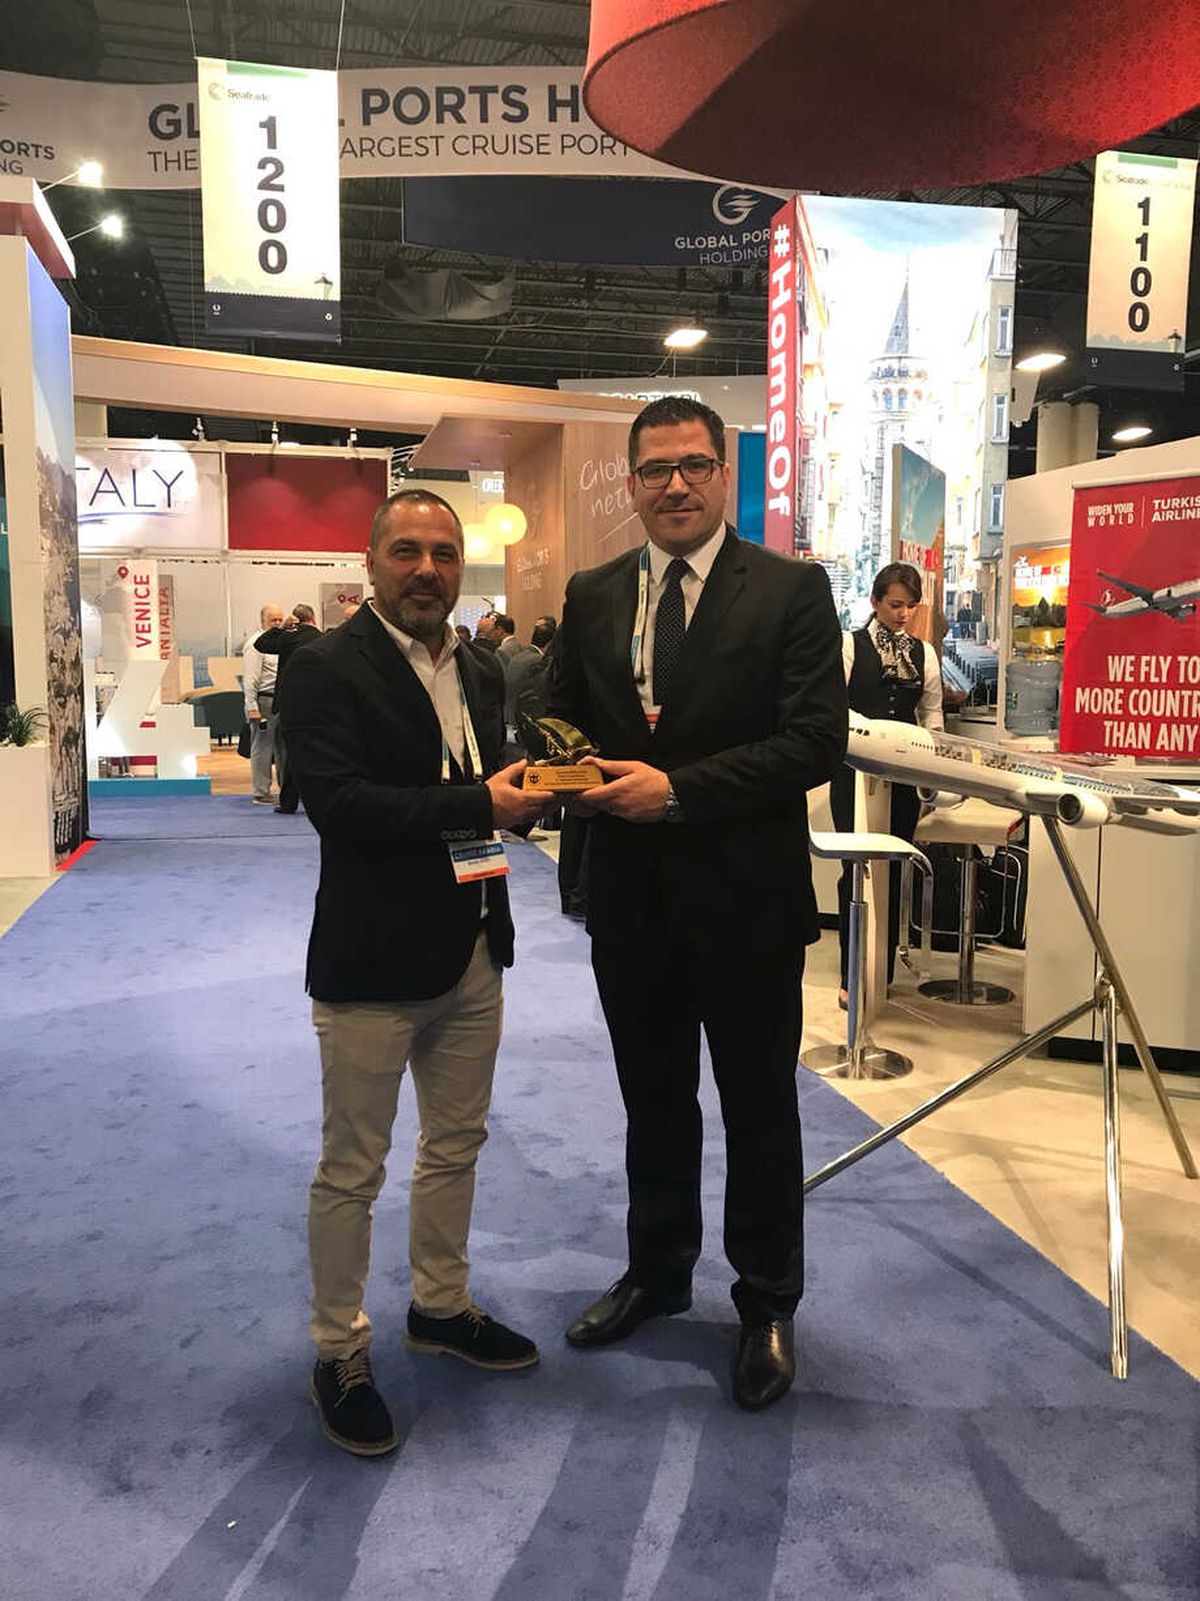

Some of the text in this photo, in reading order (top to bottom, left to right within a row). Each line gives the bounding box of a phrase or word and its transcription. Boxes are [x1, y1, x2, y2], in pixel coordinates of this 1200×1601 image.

[361, 84, 529, 126] PORTS
[147, 150, 199, 172] THE
[340, 136, 444, 159] ARGEST
[452, 134, 550, 156] CRUISE
[257, 116, 288, 274] 1200
[674, 234, 738, 249] GLOBAL
[700, 245, 768, 265] HOLDING
[1128, 197, 1151, 333] 1100
[769, 223, 791, 516] #HomeOf
[1088, 504, 1112, 517] WIDEN
[1113, 502, 1134, 515] YOUR
[134, 574, 152, 649] VENICE
[1107, 655, 1200, 684] WE FLY TO
[1075, 687, 1200, 718] MORE COUNTR
[1103, 720, 1199, 752] THAN ANY
